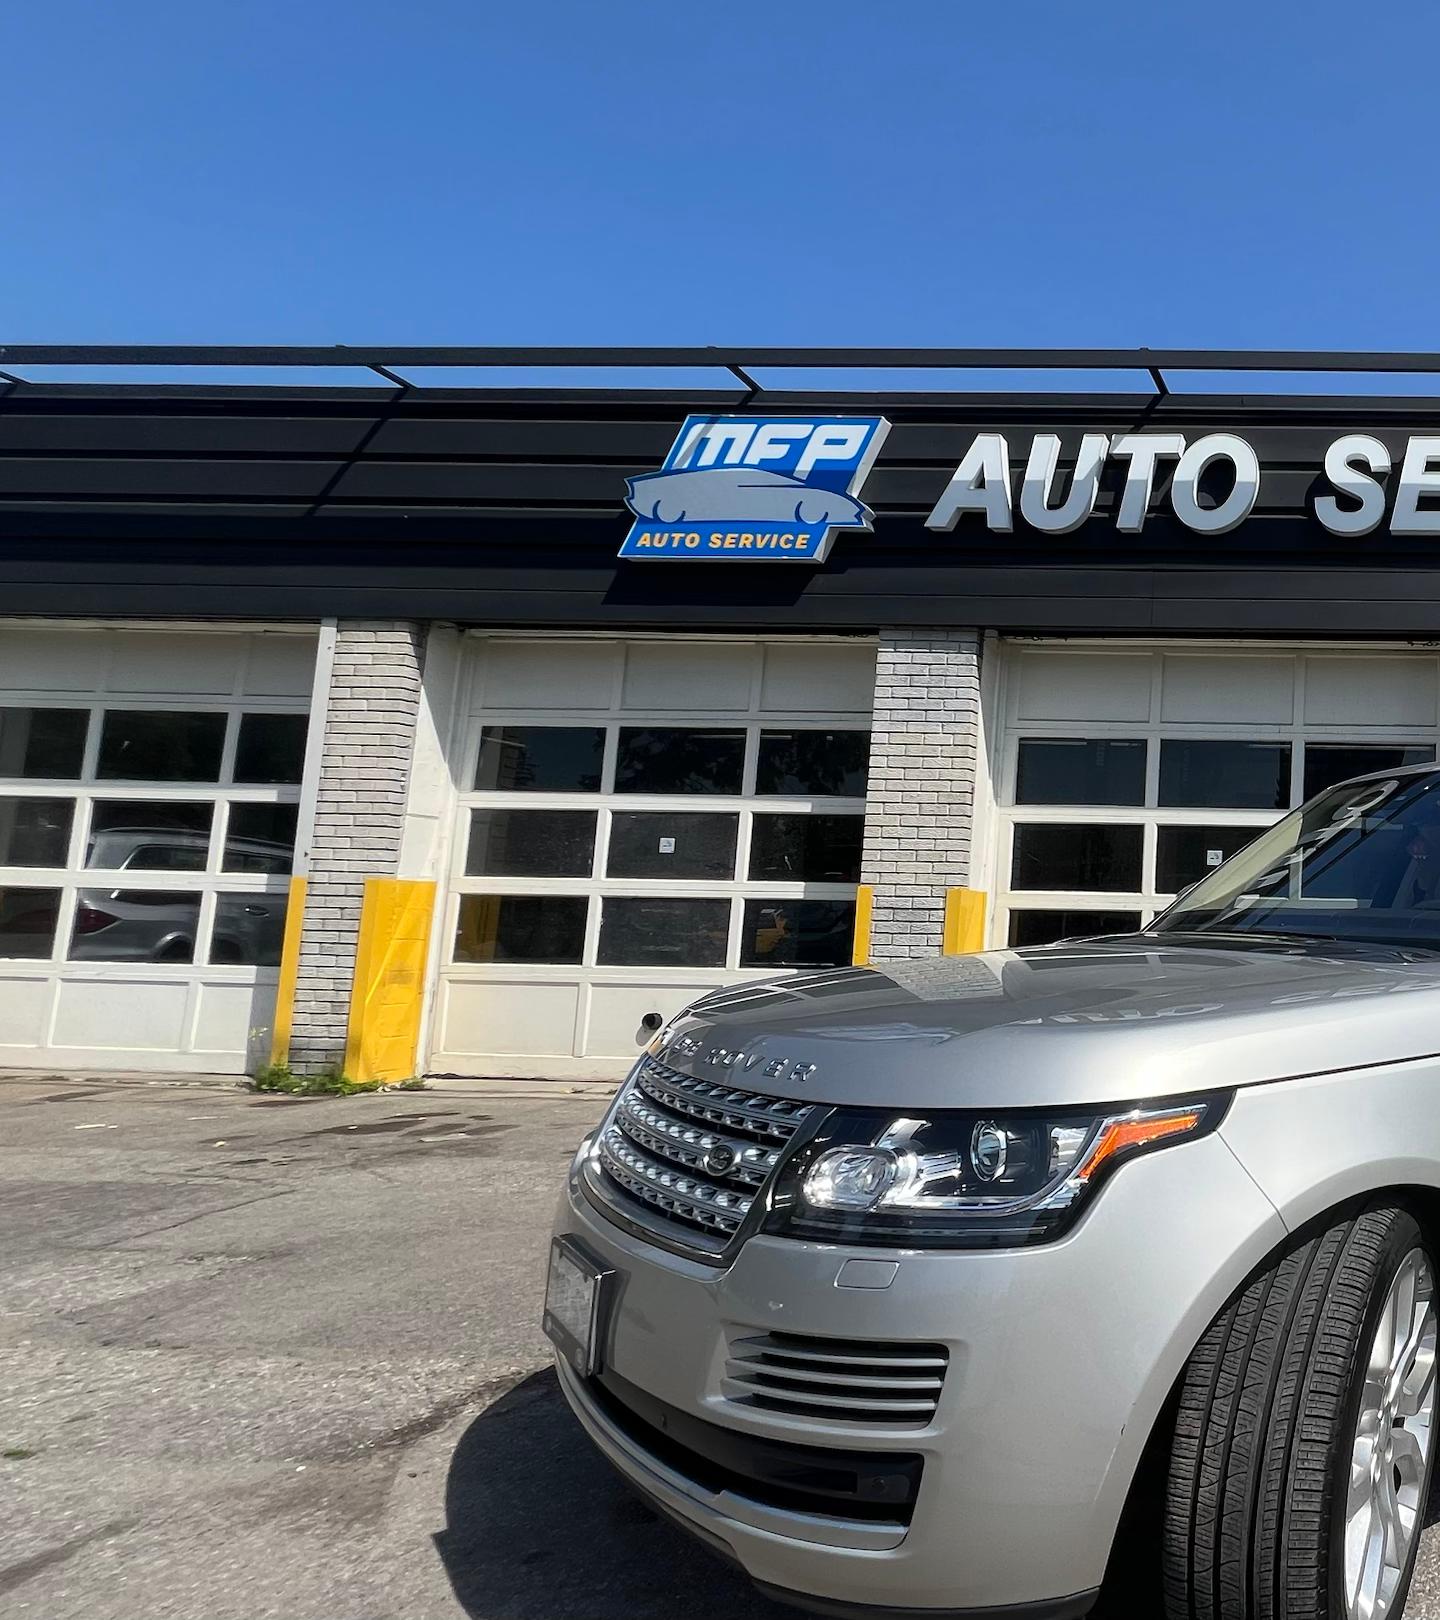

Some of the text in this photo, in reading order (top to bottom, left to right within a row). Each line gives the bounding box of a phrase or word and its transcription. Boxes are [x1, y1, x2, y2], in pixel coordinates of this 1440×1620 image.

[671, 423, 870, 480] MFP
[924, 433, 1260, 535] AUTO
[636, 532, 811, 550] AUTO SERVICE
[704, 1048, 817, 1082] ROVER
